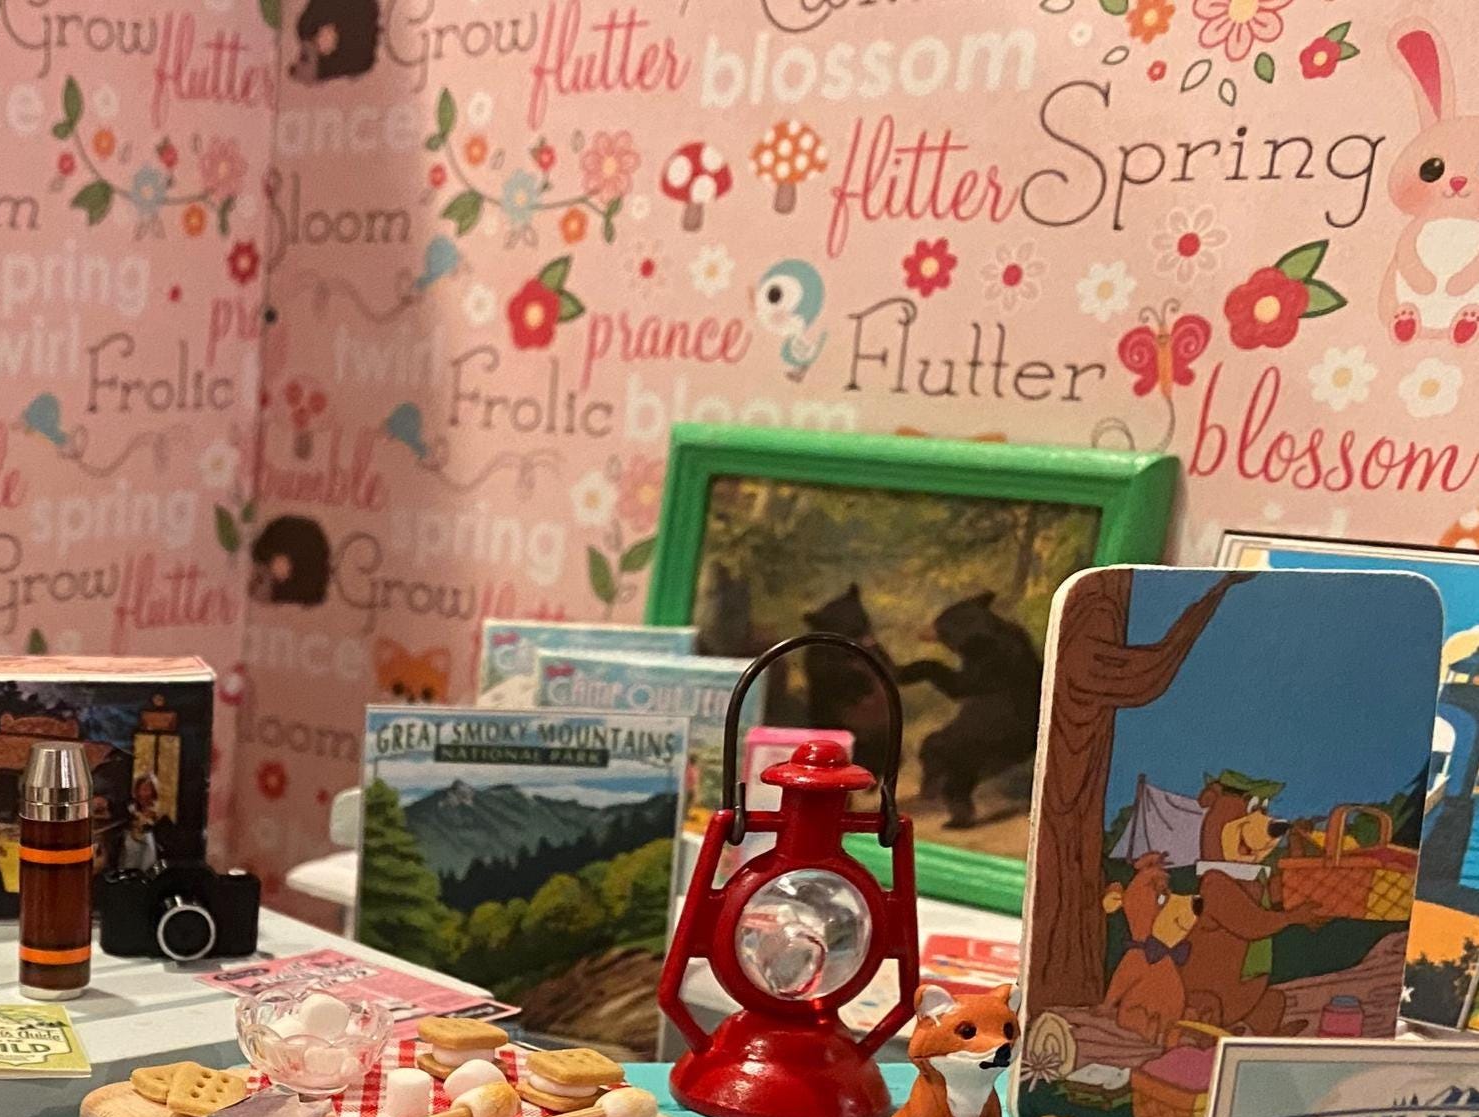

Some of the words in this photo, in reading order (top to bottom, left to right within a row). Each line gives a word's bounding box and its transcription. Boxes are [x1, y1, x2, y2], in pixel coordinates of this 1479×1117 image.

[530, 0, 693, 130] flutter
[701, 32, 1037, 110] blossom
[826, 113, 1022, 258] flitter
[1021, 80, 1387, 231] Spring
[87, 331, 237, 413] Frolic
[448, 344, 615, 438] Frolic
[578, 308, 753, 390] prance
[843, 298, 1107, 402] Flutter
[1188, 360, 1479, 492] blossom
[28, 478, 199, 550] spring
[336, 529, 478, 636] Grow
[375, 721, 444, 757] GREAT
[451, 719, 528, 747] SMOKY
[537, 721, 677, 764] MOUNTAINS
[440, 745, 539, 763] NATIONAL
[548, 749, 602, 765] PARK
